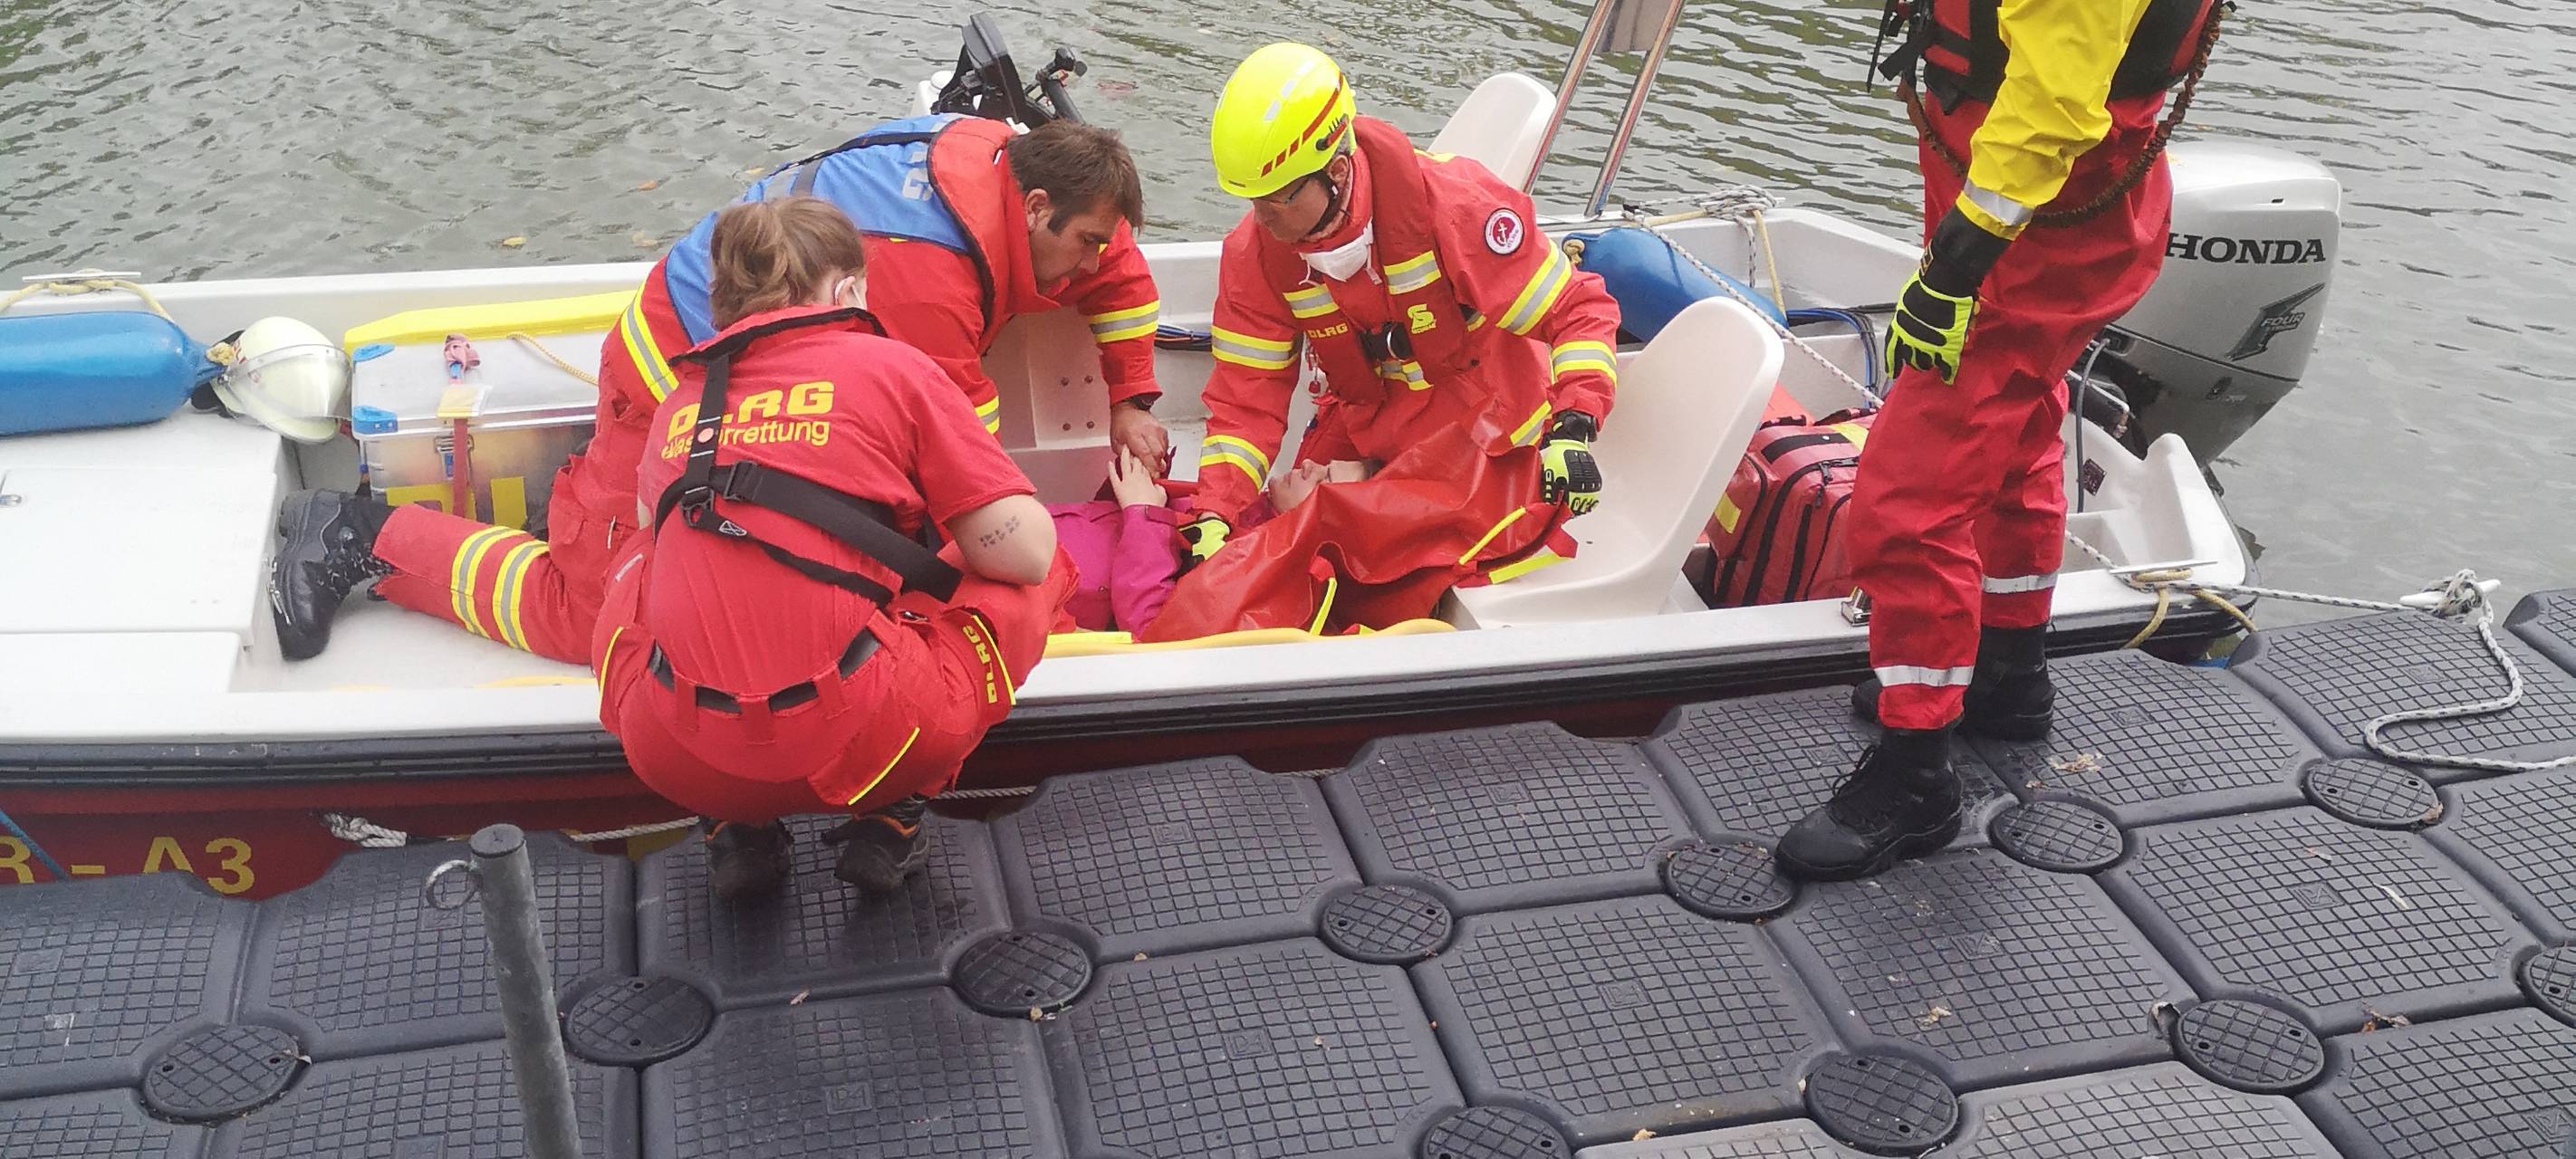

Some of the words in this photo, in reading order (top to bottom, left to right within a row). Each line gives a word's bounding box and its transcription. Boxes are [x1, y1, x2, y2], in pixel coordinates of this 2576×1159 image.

[2165, 233, 2325, 263] HONDA
[1309, 322, 1348, 338] DLRG
[667, 381, 834, 442] DRG
[962, 625, 997, 704] DLRG
